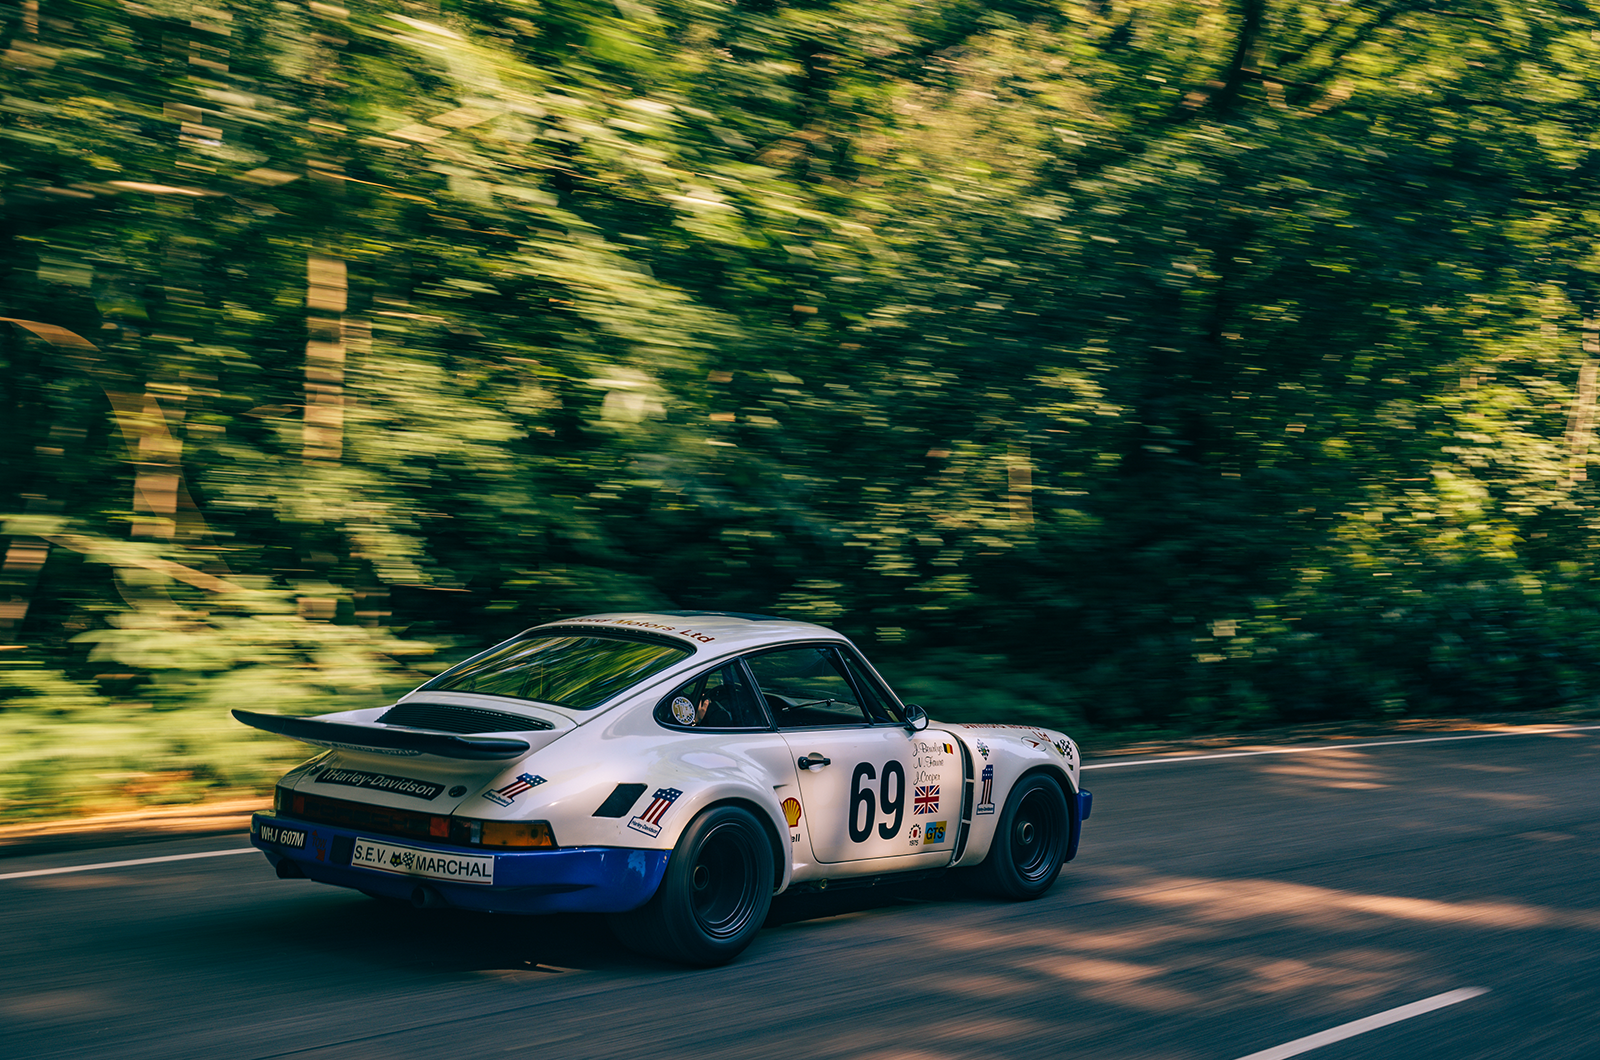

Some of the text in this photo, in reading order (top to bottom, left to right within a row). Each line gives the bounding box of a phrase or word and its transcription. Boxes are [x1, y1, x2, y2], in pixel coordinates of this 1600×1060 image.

[611, 619, 676, 632] Motors
[679, 629, 716, 643] Ltd
[848, 760, 905, 843] 69
[260, 825, 305, 847] WHJ 607M
[312, 836, 328, 849] TOW
[791, 833, 800, 843] ell
[926, 826, 944, 840] GTS
[354, 845, 492, 877] S.E.V. MARCHAL
